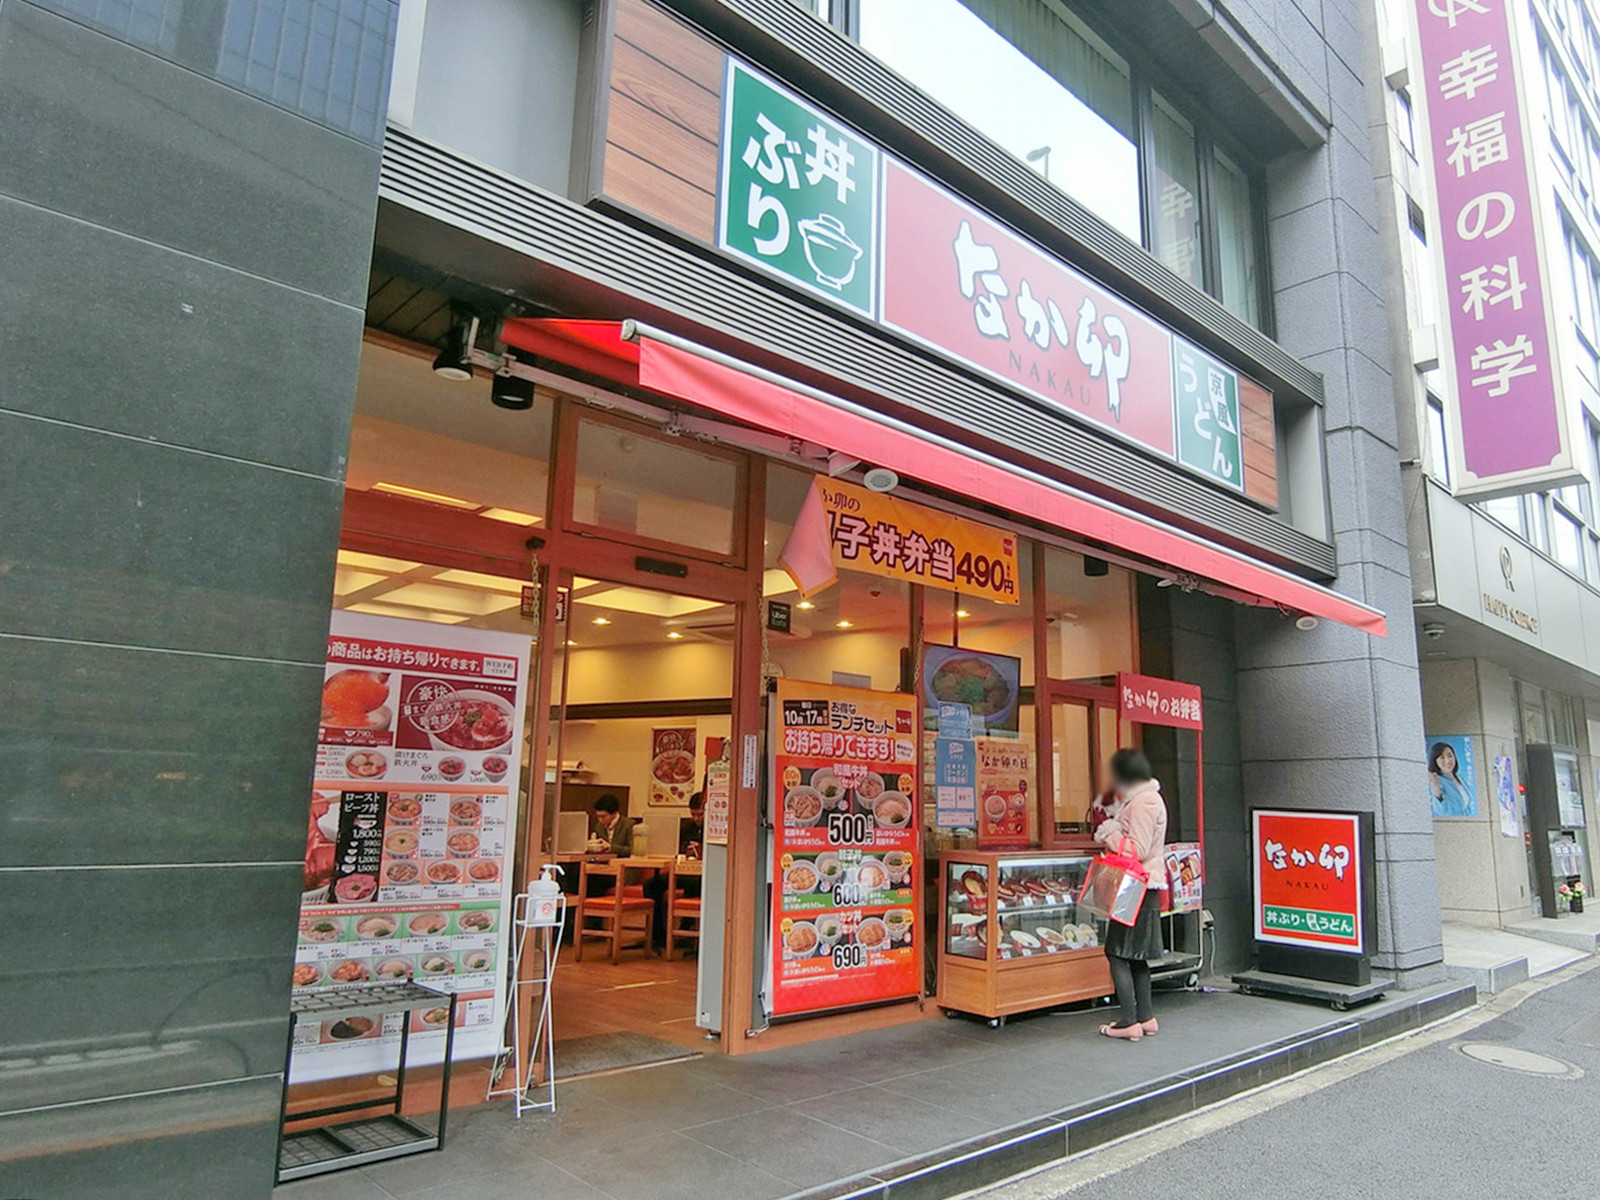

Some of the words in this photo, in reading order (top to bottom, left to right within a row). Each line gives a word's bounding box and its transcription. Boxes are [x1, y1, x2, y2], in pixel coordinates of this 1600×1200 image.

[1438, 44, 1537, 398] 幸福の科学
[953, 219, 1131, 424] なか卯
[1008, 349, 1091, 406] NAKAU
[1179, 352, 1233, 478] うどん
[831, 714, 894, 734] ランチセット
[345, 793, 380, 802] ロースト
[1264, 839, 1350, 882] なか卯
[1286, 880, 1329, 891] NAKAU
